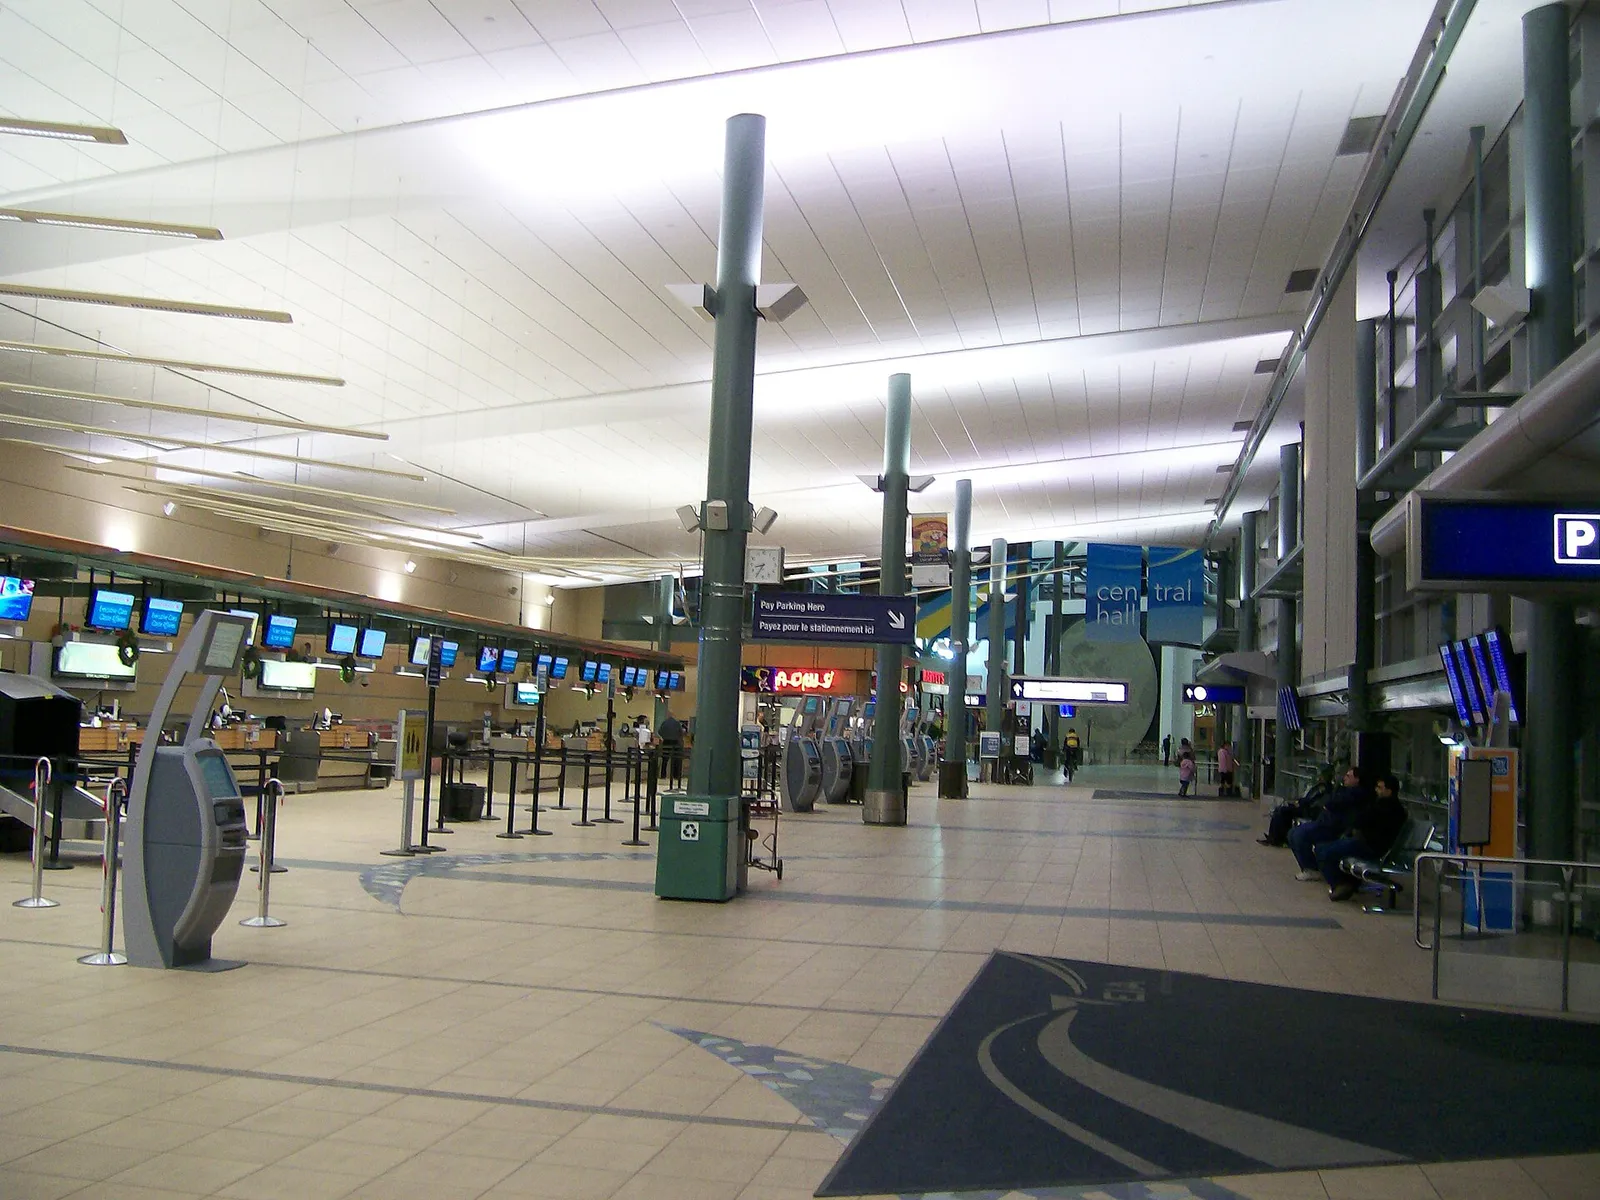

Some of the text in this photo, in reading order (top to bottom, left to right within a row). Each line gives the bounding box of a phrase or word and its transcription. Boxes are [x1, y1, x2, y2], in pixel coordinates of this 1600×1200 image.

[1566, 520, 1596, 557] P
[760, 600, 826, 613] Pay Parking Here
[1097, 603, 1136, 626] hall
[759, 621, 875, 634] Payez pour le stationnement ici
